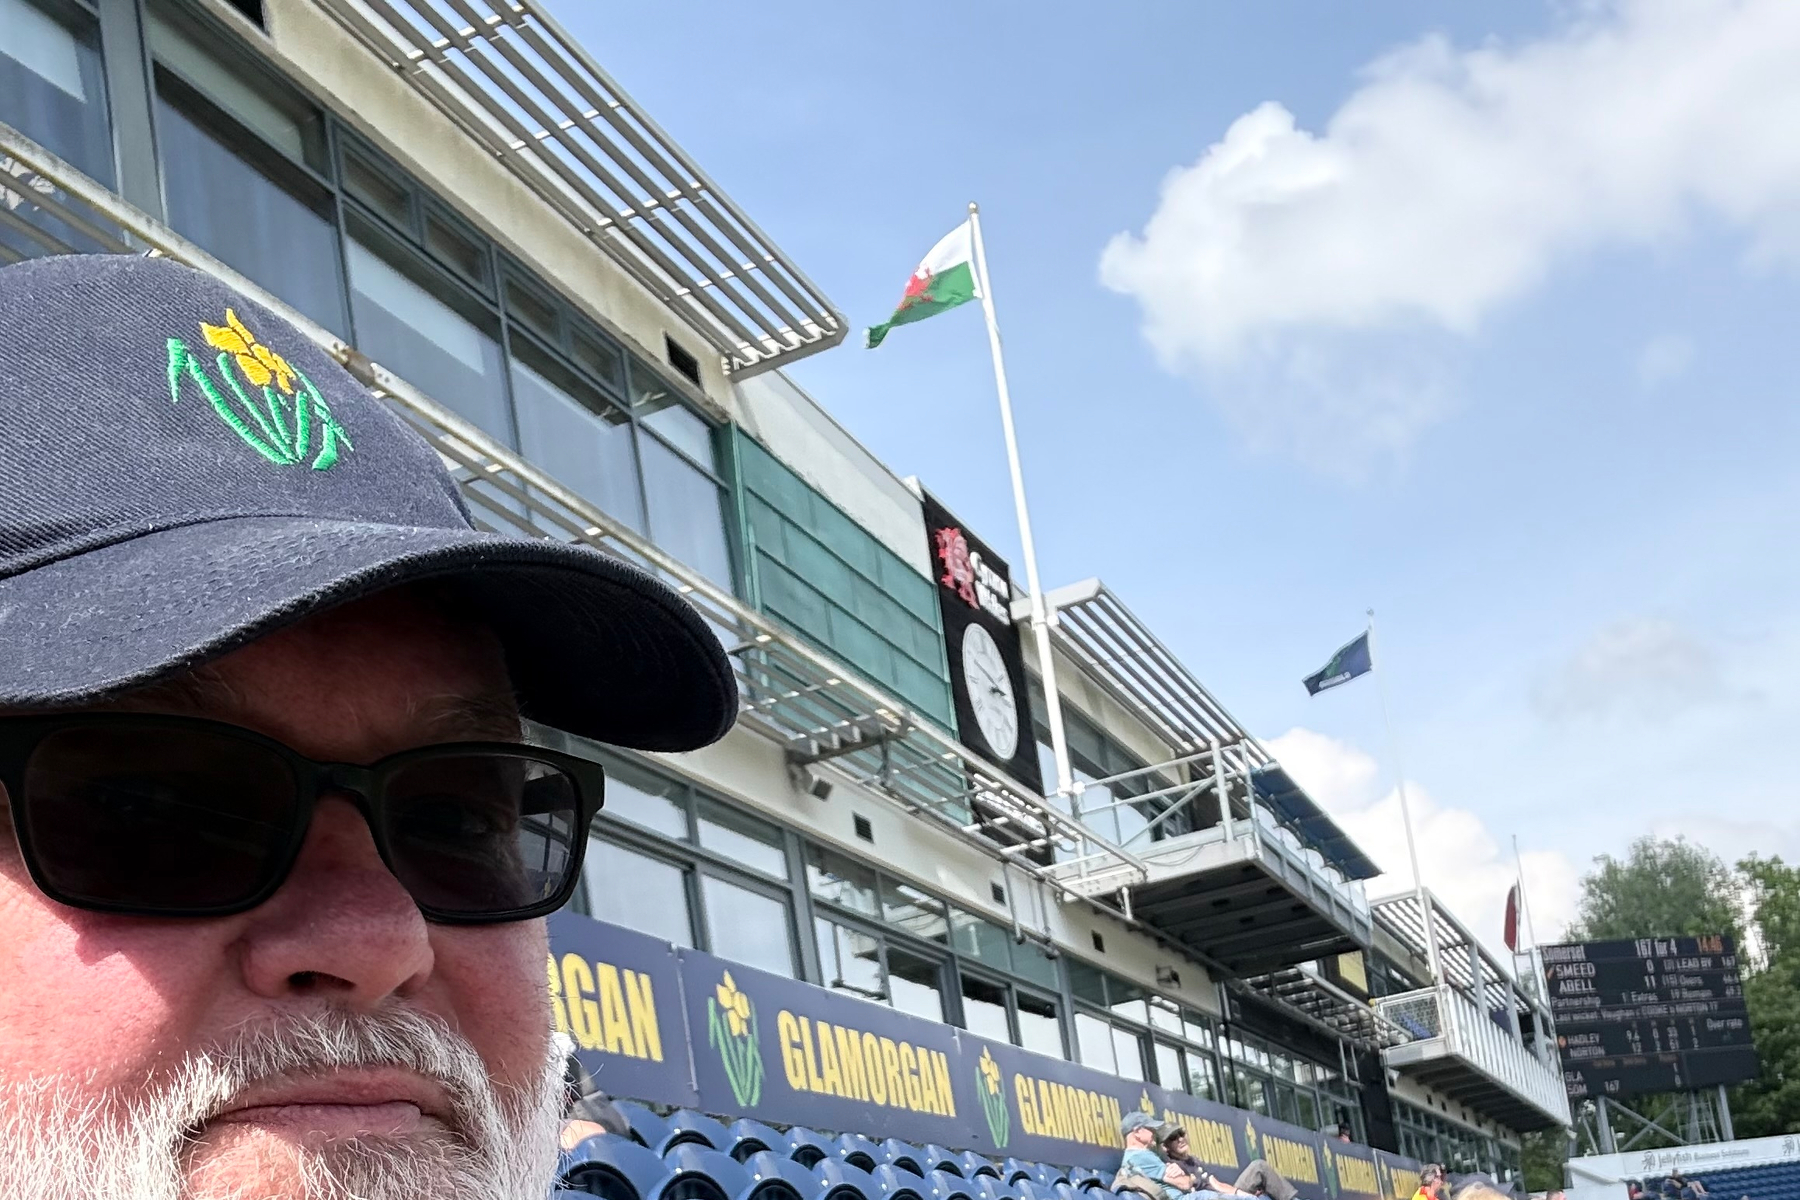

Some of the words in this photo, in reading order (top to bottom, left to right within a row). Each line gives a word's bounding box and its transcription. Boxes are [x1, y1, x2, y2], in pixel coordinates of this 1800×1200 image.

[1543, 946, 1585, 961] Somerset
[1635, 940, 1652, 956] 167
[1669, 939, 1678, 955] 4
[1555, 963, 1596, 977] SMEED
[1676, 958, 1699, 969] LEAD
[1558, 980, 1596, 993] ABELL
[1644, 976, 1656, 988] 11
[1551, 995, 1602, 1011] Partnership
[1631, 991, 1658, 1003] Extras
[1706, 1018, 1725, 1031] Over
[1569, 1046, 1605, 1058] NORTON
[777, 1009, 957, 1118] GLAMORGAN
[1604, 1081, 1621, 1091] 167
[1013, 1073, 1126, 1149] GLAMORGAN
